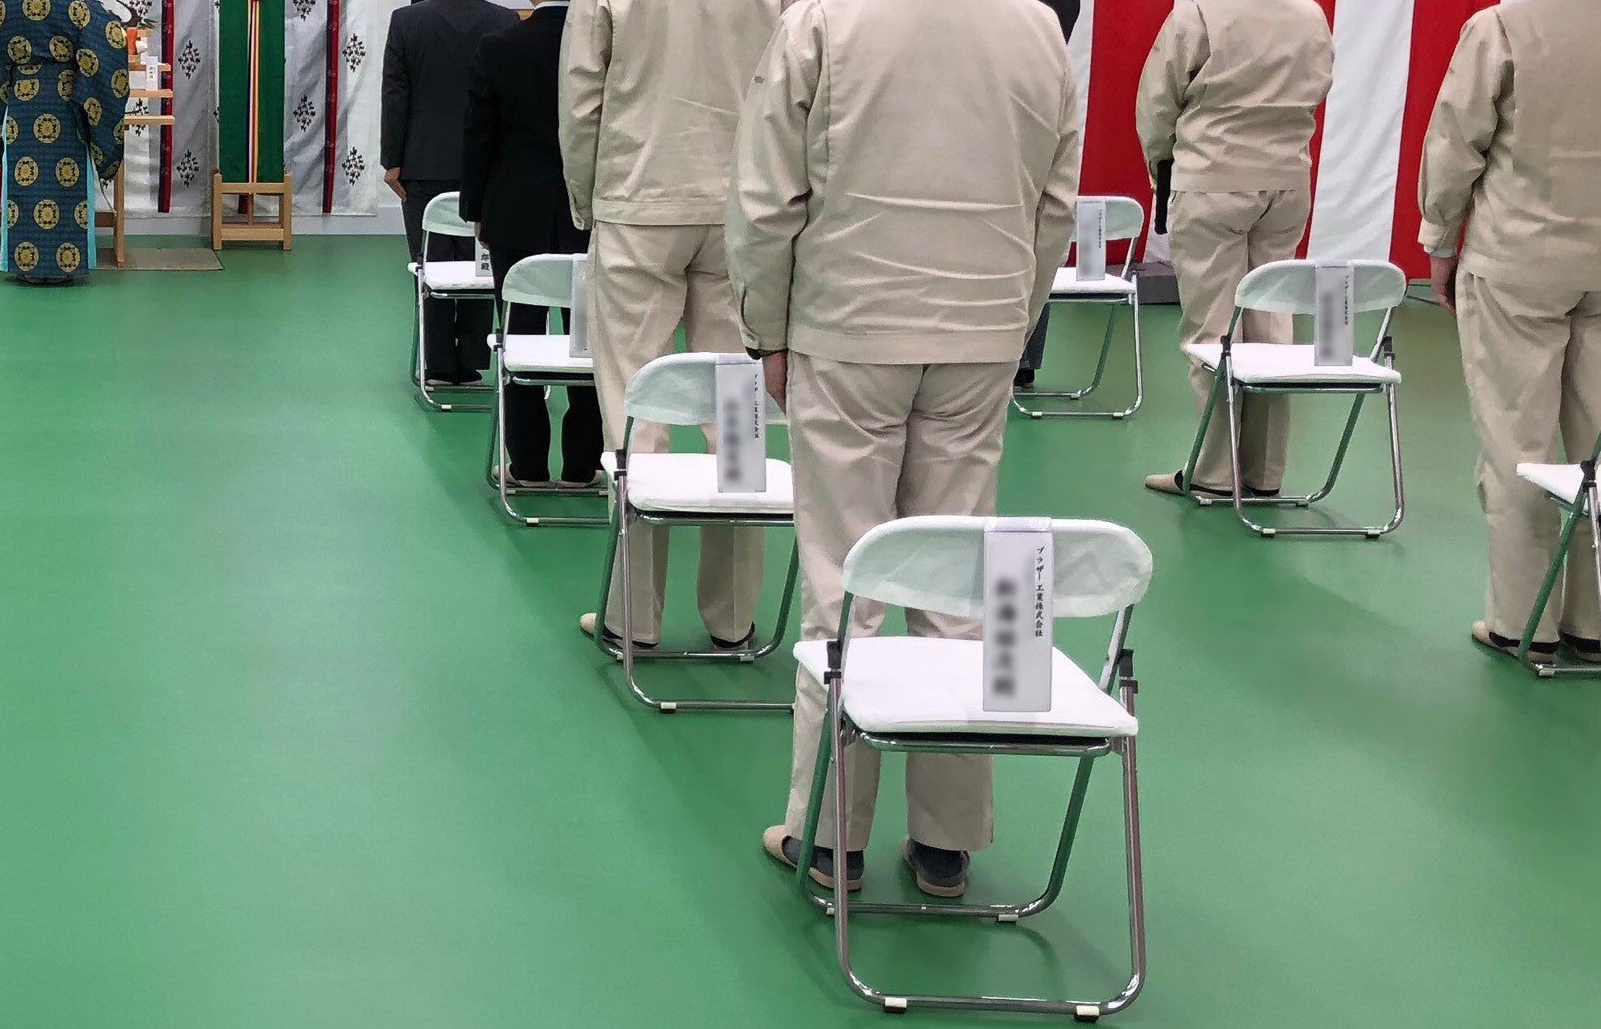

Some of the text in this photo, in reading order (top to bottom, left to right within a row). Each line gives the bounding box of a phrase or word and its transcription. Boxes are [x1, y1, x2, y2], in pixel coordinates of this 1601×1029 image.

[1035, 545, 1045, 638] ブラザー工業株式会社
